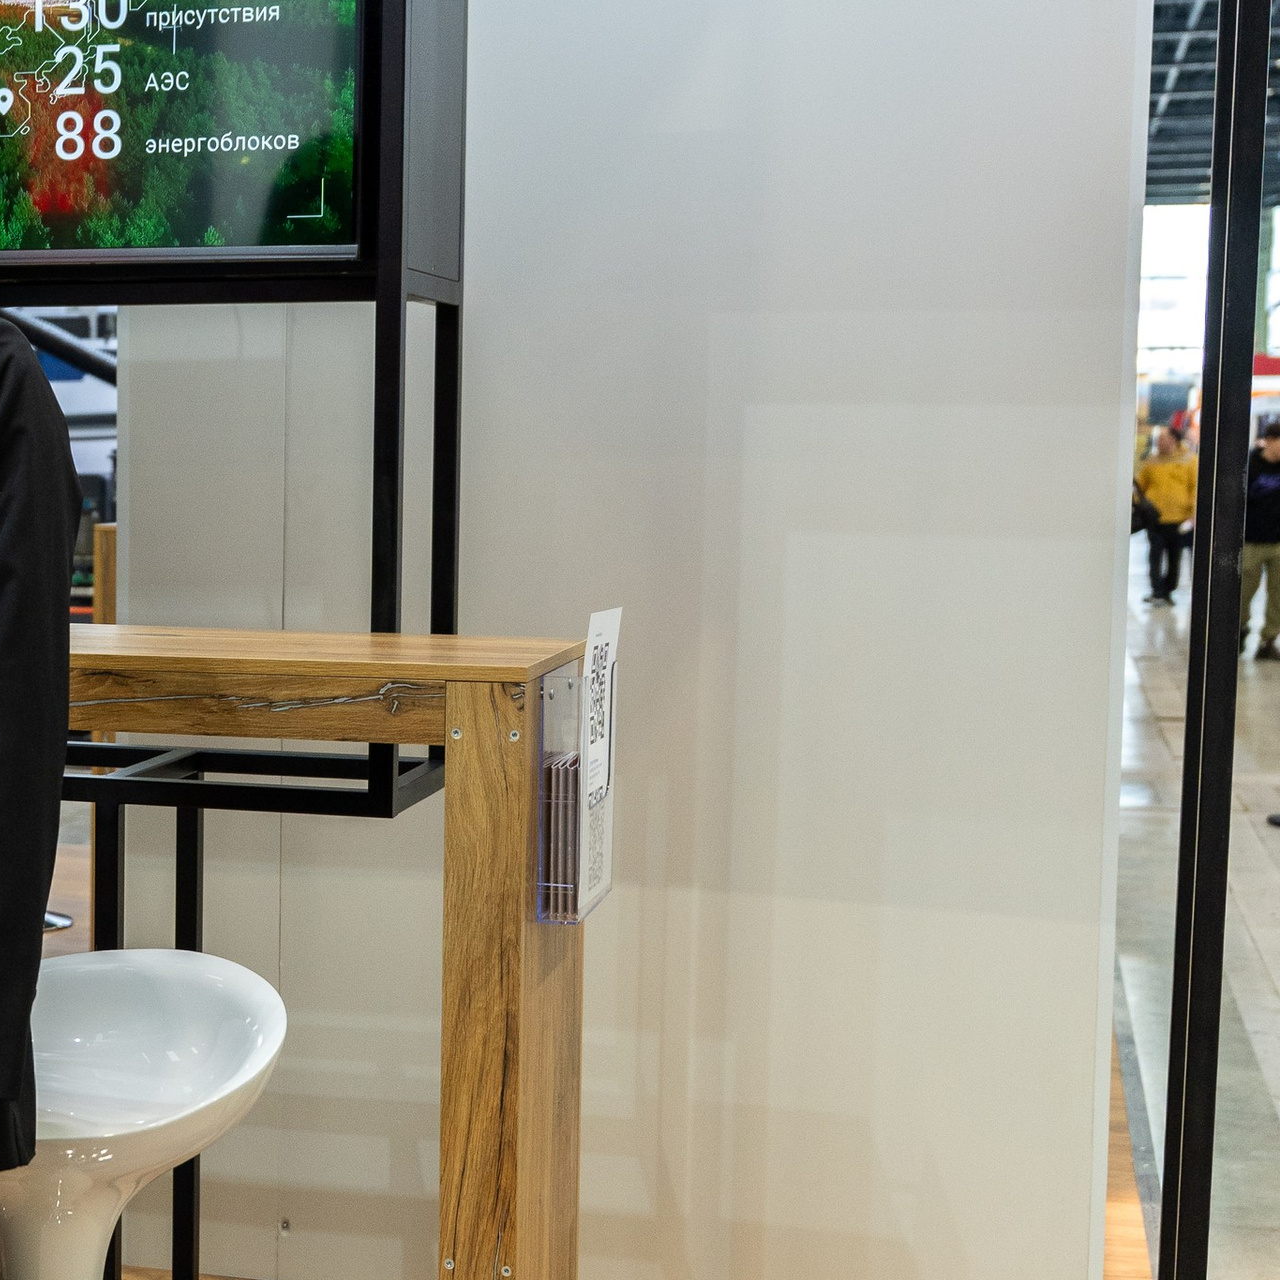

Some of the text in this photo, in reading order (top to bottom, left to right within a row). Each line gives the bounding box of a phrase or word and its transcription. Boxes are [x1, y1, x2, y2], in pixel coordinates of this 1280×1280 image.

[146, 5, 280, 32] присутствия
[55, 43, 190, 95] 25 АЭС
[55, 109, 300, 160] 88 энергоблоков
